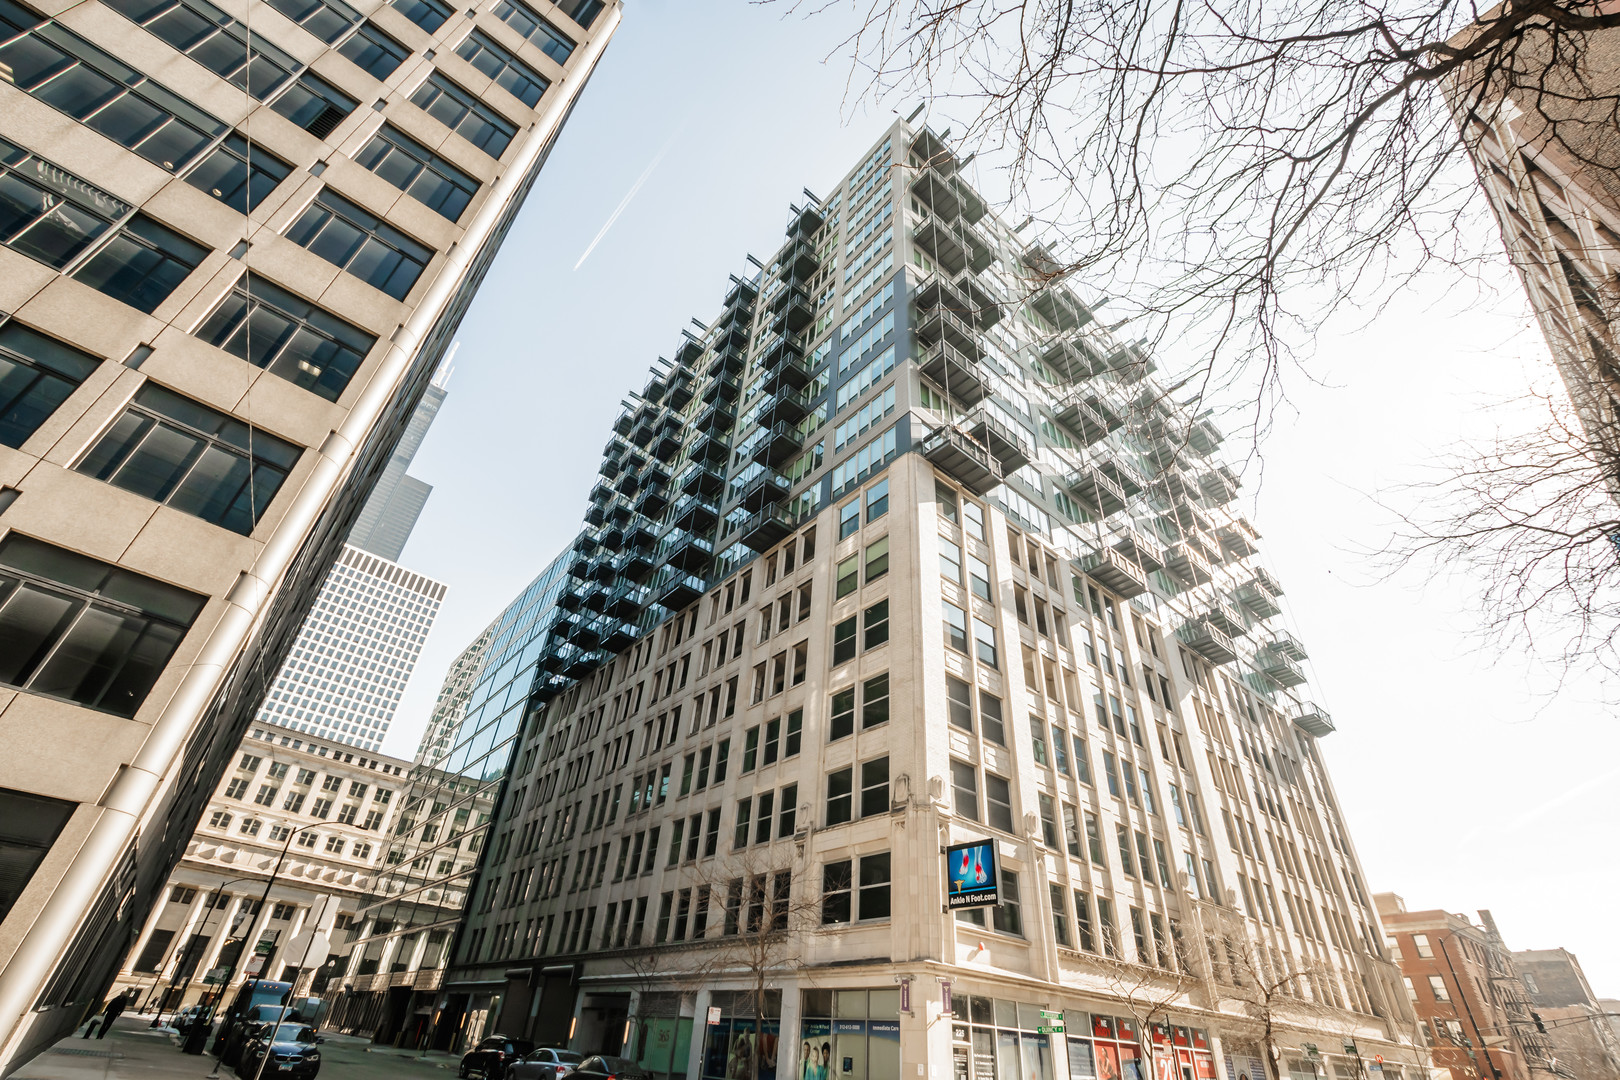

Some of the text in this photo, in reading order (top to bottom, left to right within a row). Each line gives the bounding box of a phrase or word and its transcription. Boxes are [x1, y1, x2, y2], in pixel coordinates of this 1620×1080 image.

[950, 893, 997, 905] Ankle N Foot.com
